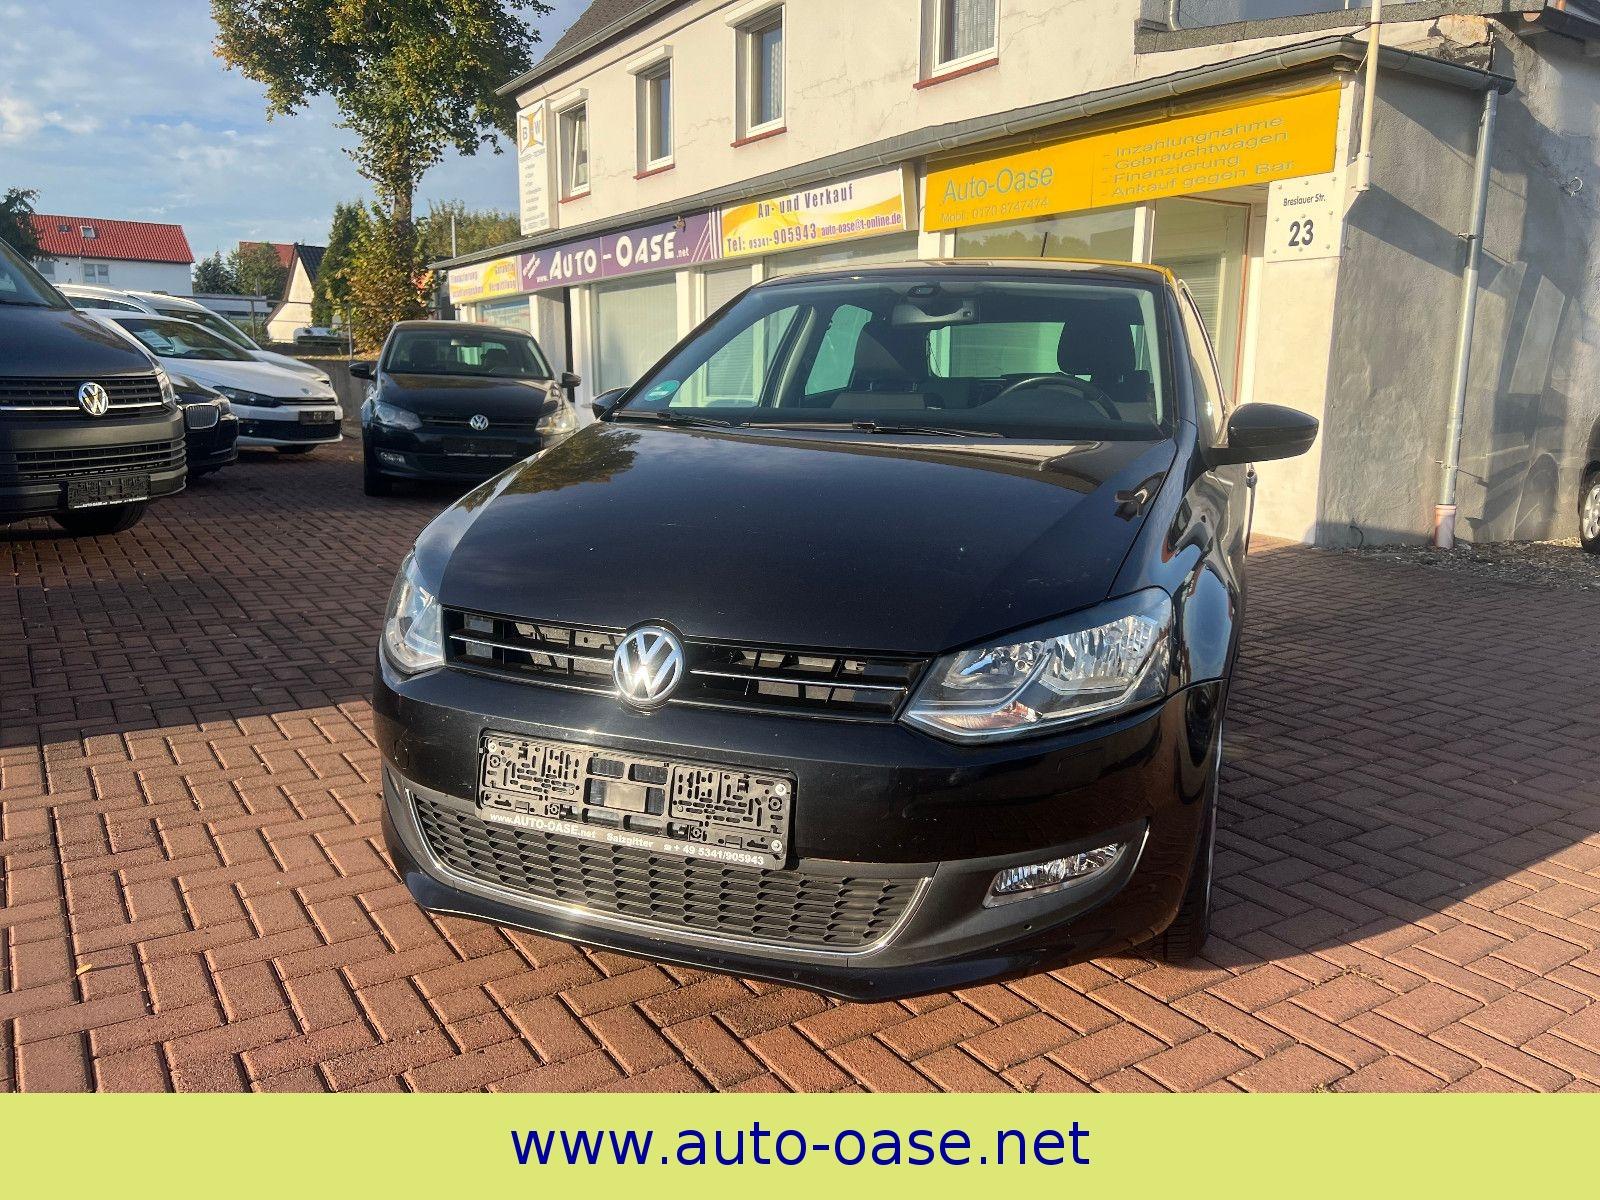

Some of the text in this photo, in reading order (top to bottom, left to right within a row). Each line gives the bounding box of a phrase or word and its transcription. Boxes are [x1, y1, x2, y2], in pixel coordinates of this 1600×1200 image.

[1115, 131, 1289, 171] Gebrauchtwagen
[1116, 117, 1284, 157] Inzahlungnahme
[943, 165, 1054, 204] Auto-Oase
[1112, 160, 1294, 198] Ankauf gegen Bar
[1114, 155, 1241, 184] Finanzierung
[758, 183, 853, 219] An- und Verkauf
[1283, 193, 1326, 207] Breslauer Str.
[727, 237, 746, 253] Tel:
[821, 212, 902, 237] auto-oase@t-online.de
[1288, 219, 1314, 247] 23
[490, 812, 596, 839] www.AUTO-OASE.net
[606, 832, 654, 848] Salzgitter
